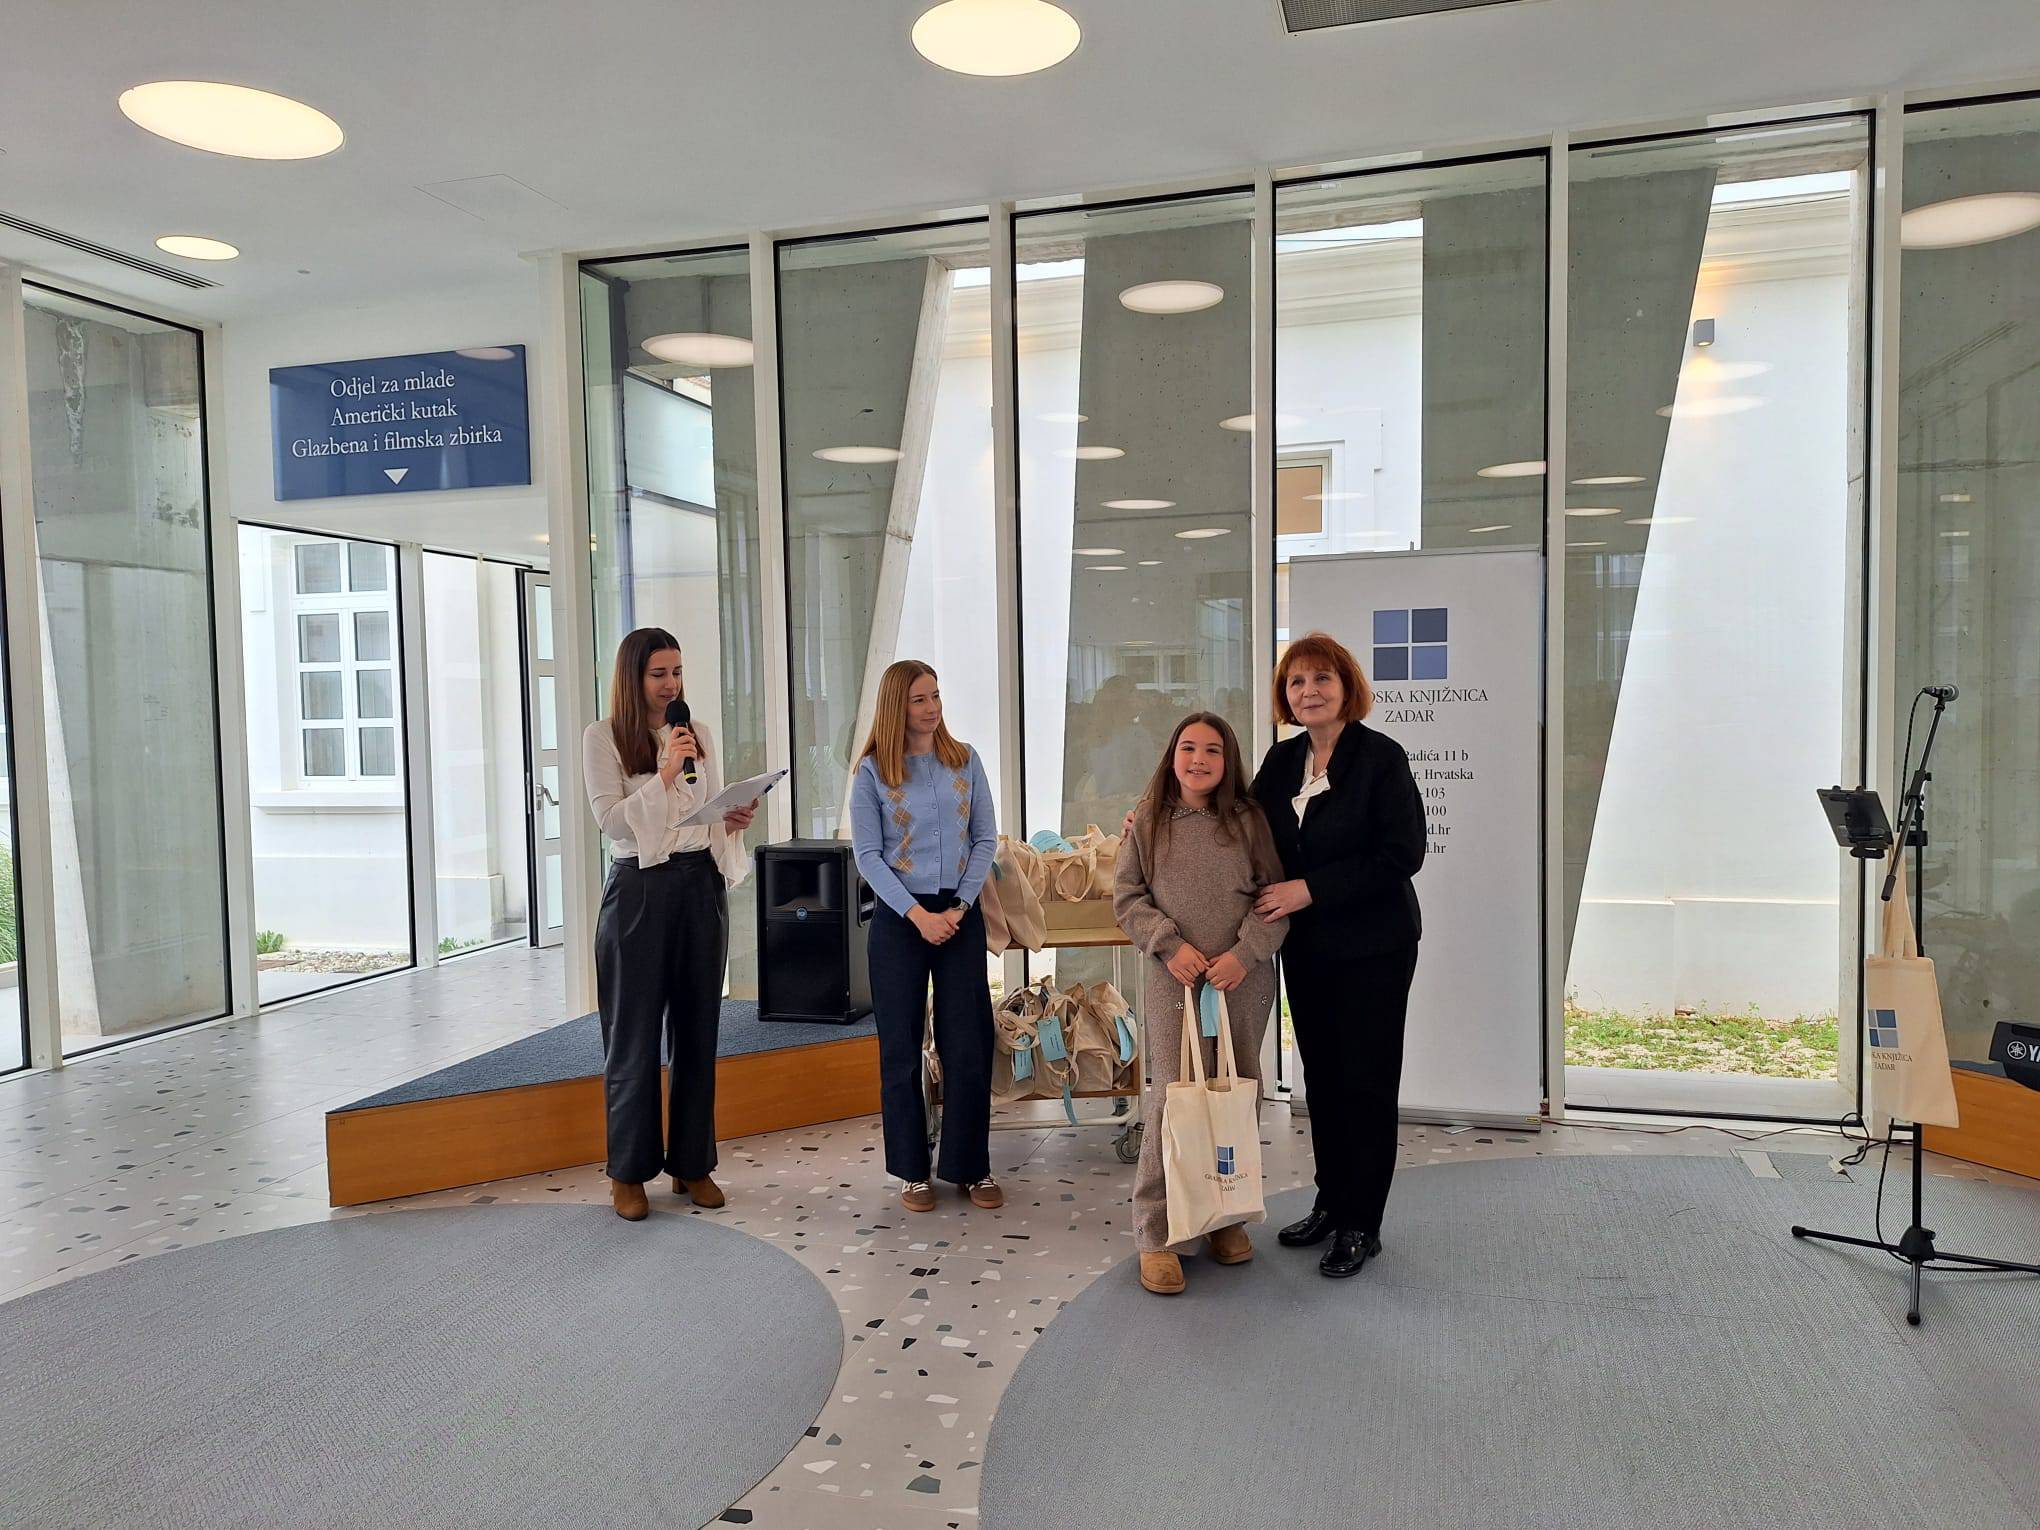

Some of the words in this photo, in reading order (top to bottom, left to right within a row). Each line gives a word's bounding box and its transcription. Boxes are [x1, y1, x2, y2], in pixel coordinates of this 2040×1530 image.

[330, 376, 376, 400] Odjel
[381, 378, 399, 392] za
[404, 369, 455, 391] mlade
[331, 403, 405, 426] Američki
[411, 399, 458, 419] kutak
[292, 436, 368, 458] Glazbena
[373, 434, 379, 452] i
[384, 431, 444, 450] filmska
[450, 425, 502, 446] zbirka
[1410, 686, 1488, 705] KNJIŽNICA
[1384, 710, 1435, 723] ZADAR
[1445, 750, 1456, 761] 11
[1461, 749, 1469, 761] b
[1425, 768, 1474, 780] Hrvatska
